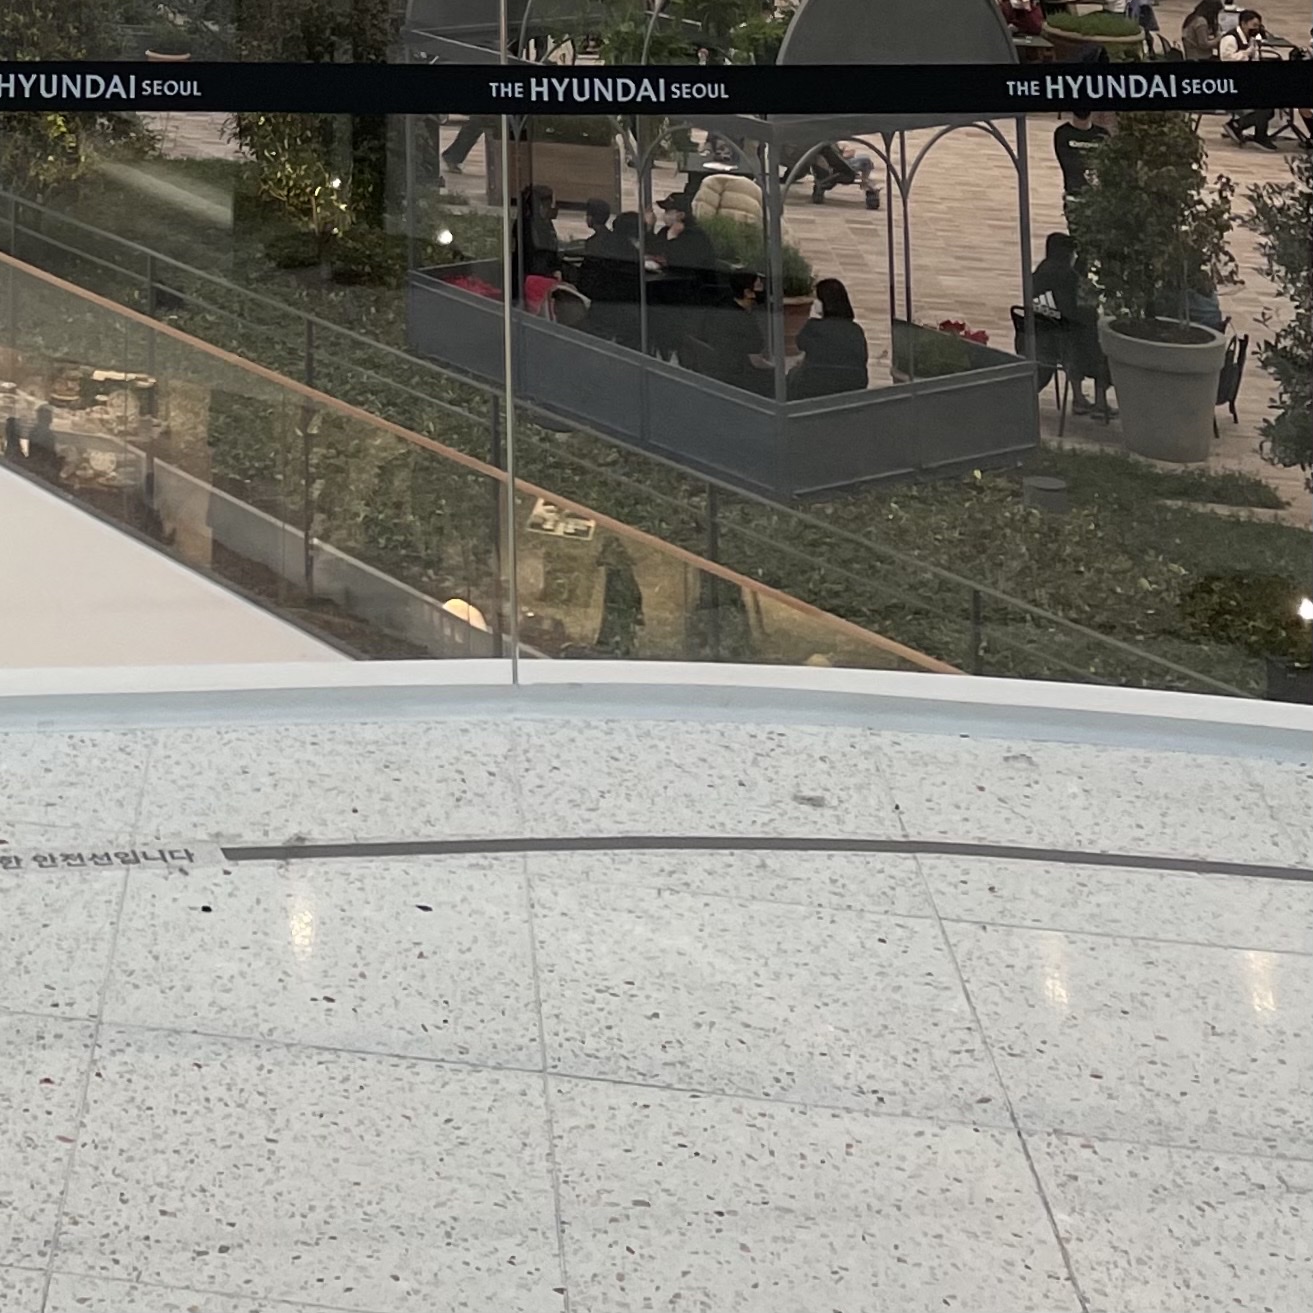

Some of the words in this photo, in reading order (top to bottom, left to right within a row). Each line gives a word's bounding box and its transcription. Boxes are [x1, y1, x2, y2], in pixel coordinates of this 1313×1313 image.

[141, 80, 202, 97] SEOUL
[489, 82, 524, 98] THE
[530, 77, 665, 102] HYUNDAI
[671, 82, 729, 99] SEOUL
[1006, 80, 1040, 97] THE
[1045, 74, 1177, 99] HYUNDAI
[1182, 78, 1238, 95] SEOUL
[1032, 303, 1062, 320] didas
[31, 848, 195, 869] 안전선입니다
